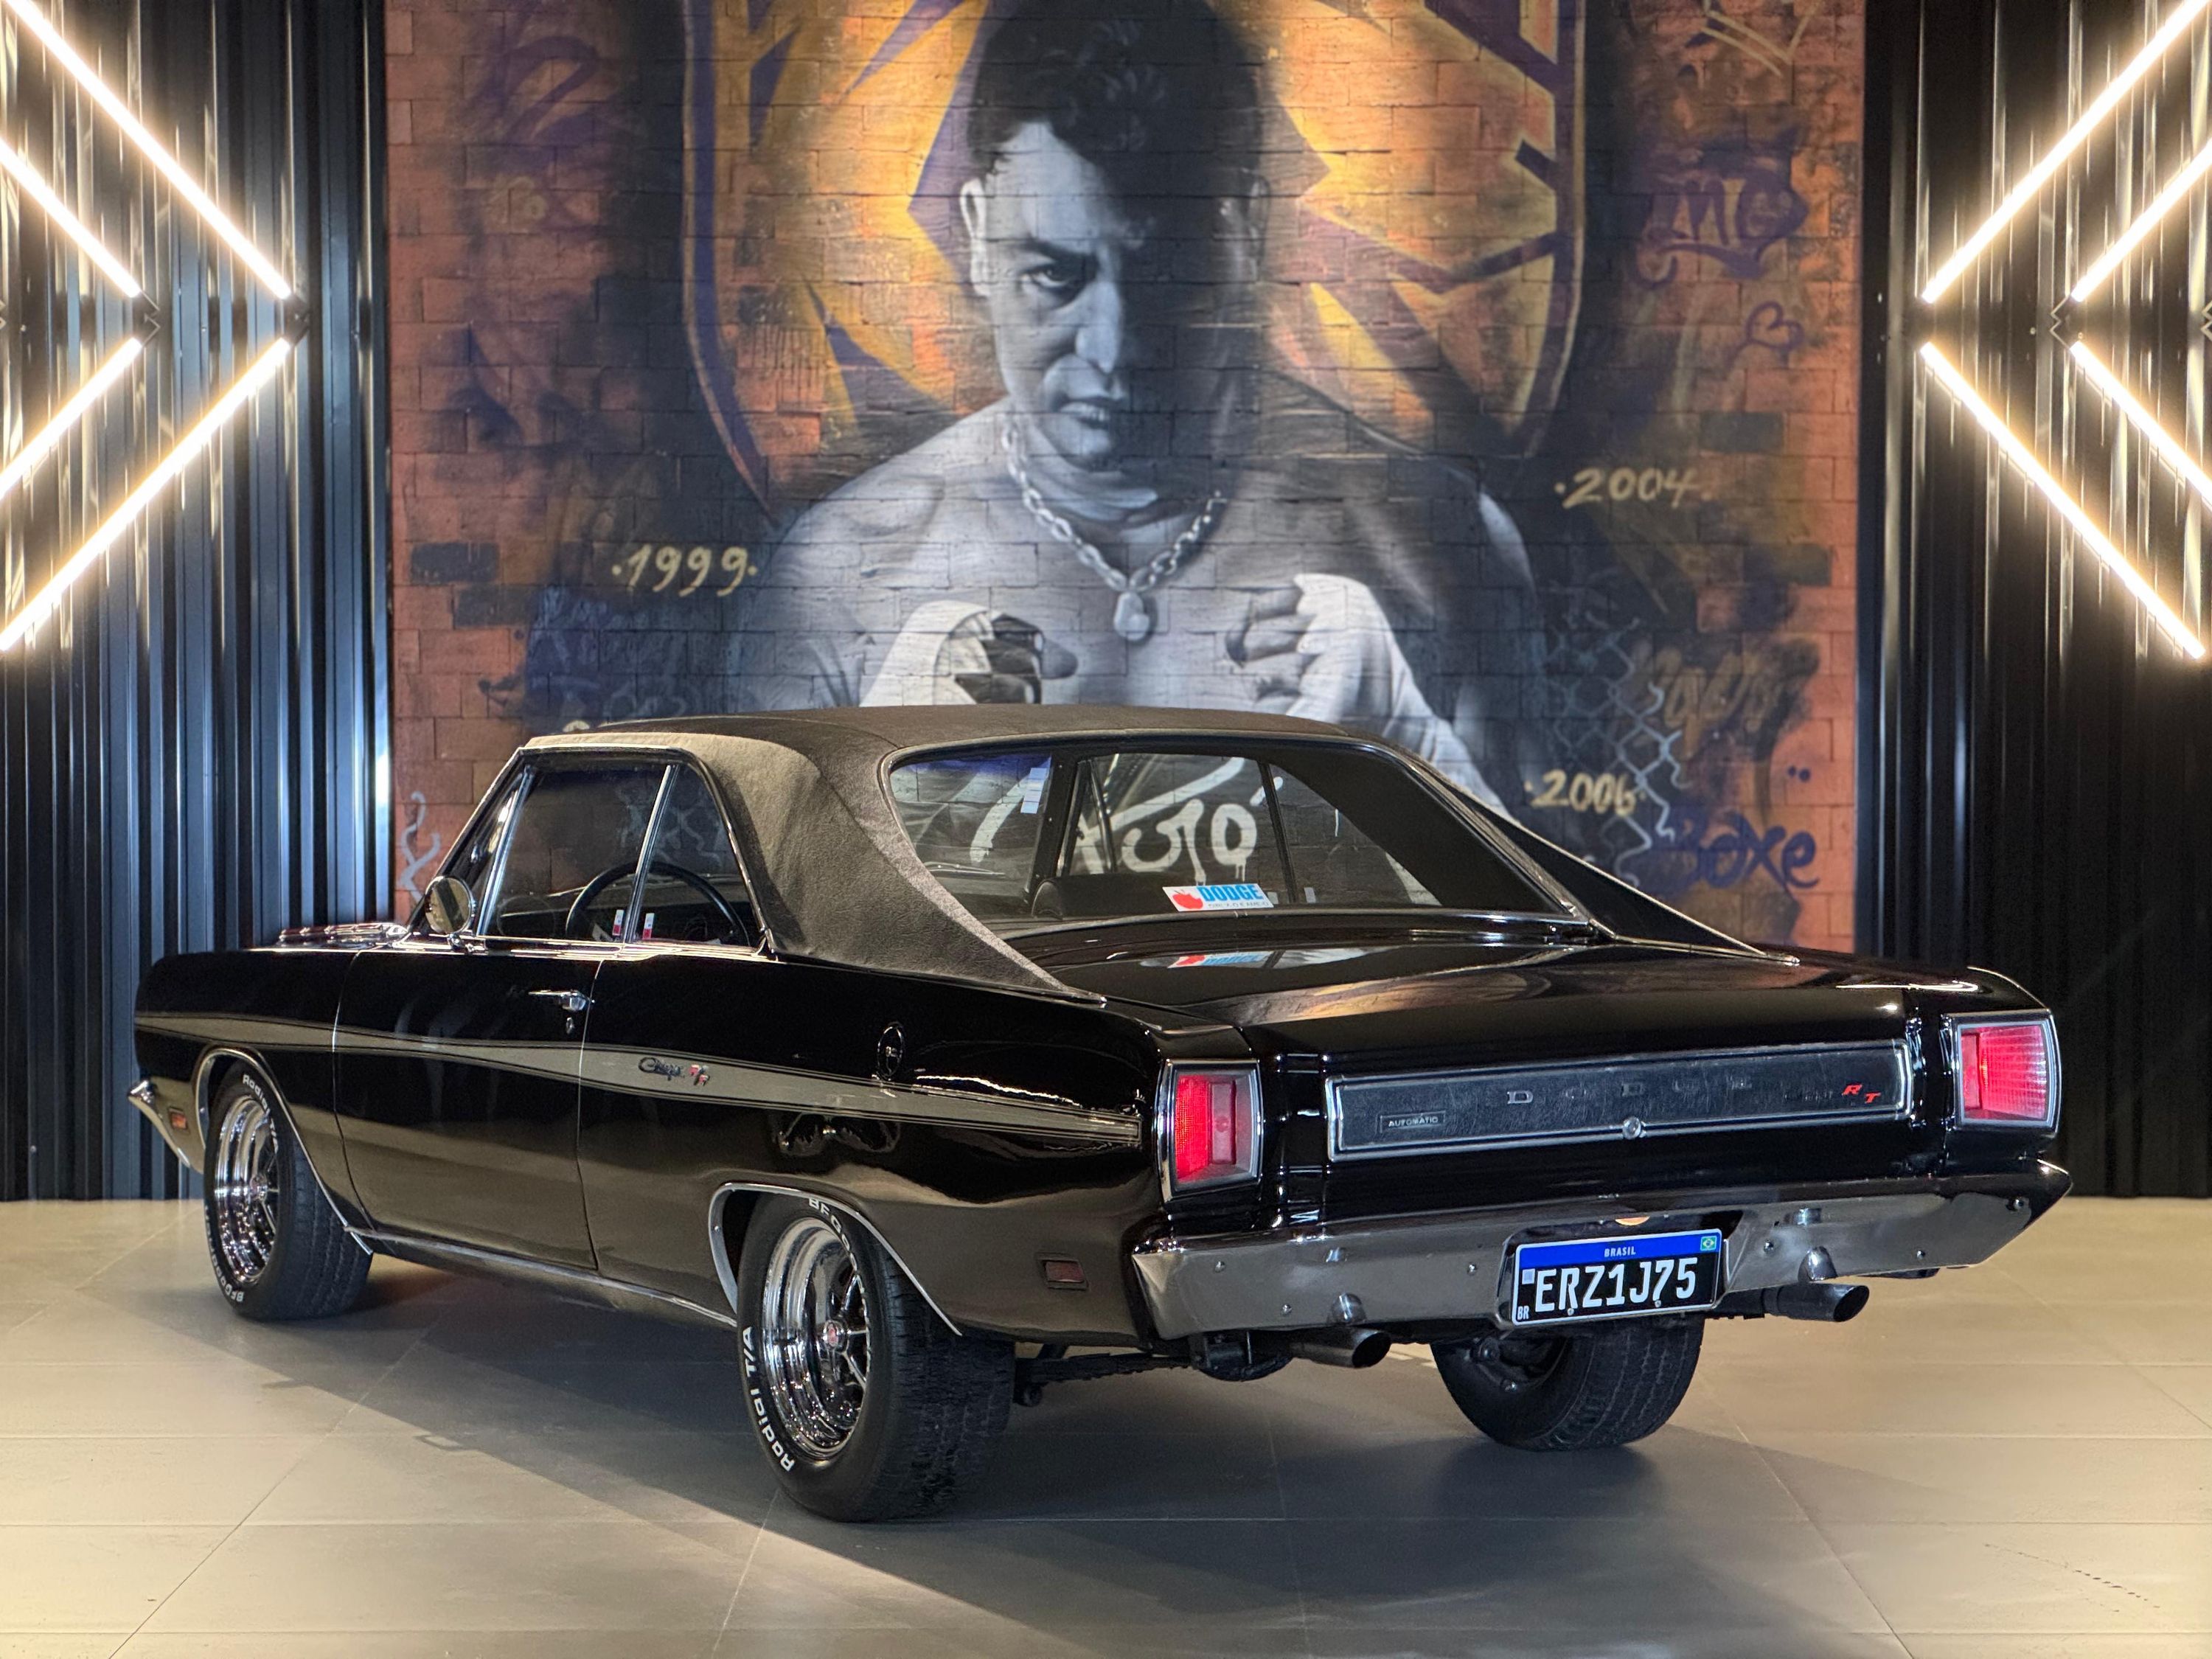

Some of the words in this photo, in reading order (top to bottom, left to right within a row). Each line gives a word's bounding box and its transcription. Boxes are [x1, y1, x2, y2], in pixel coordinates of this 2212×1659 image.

[1196, 884, 1265, 902] DODGE
[1388, 1115, 1439, 1127] AUTOMATIC
[1604, 1246, 1636, 1258] BRASIL
[1534, 1256, 1698, 1313] ERZ1J75
[1517, 1306, 1529, 1321] BR
[742, 1326, 758, 1378] T/A
[750, 1387, 796, 1472] Radial
